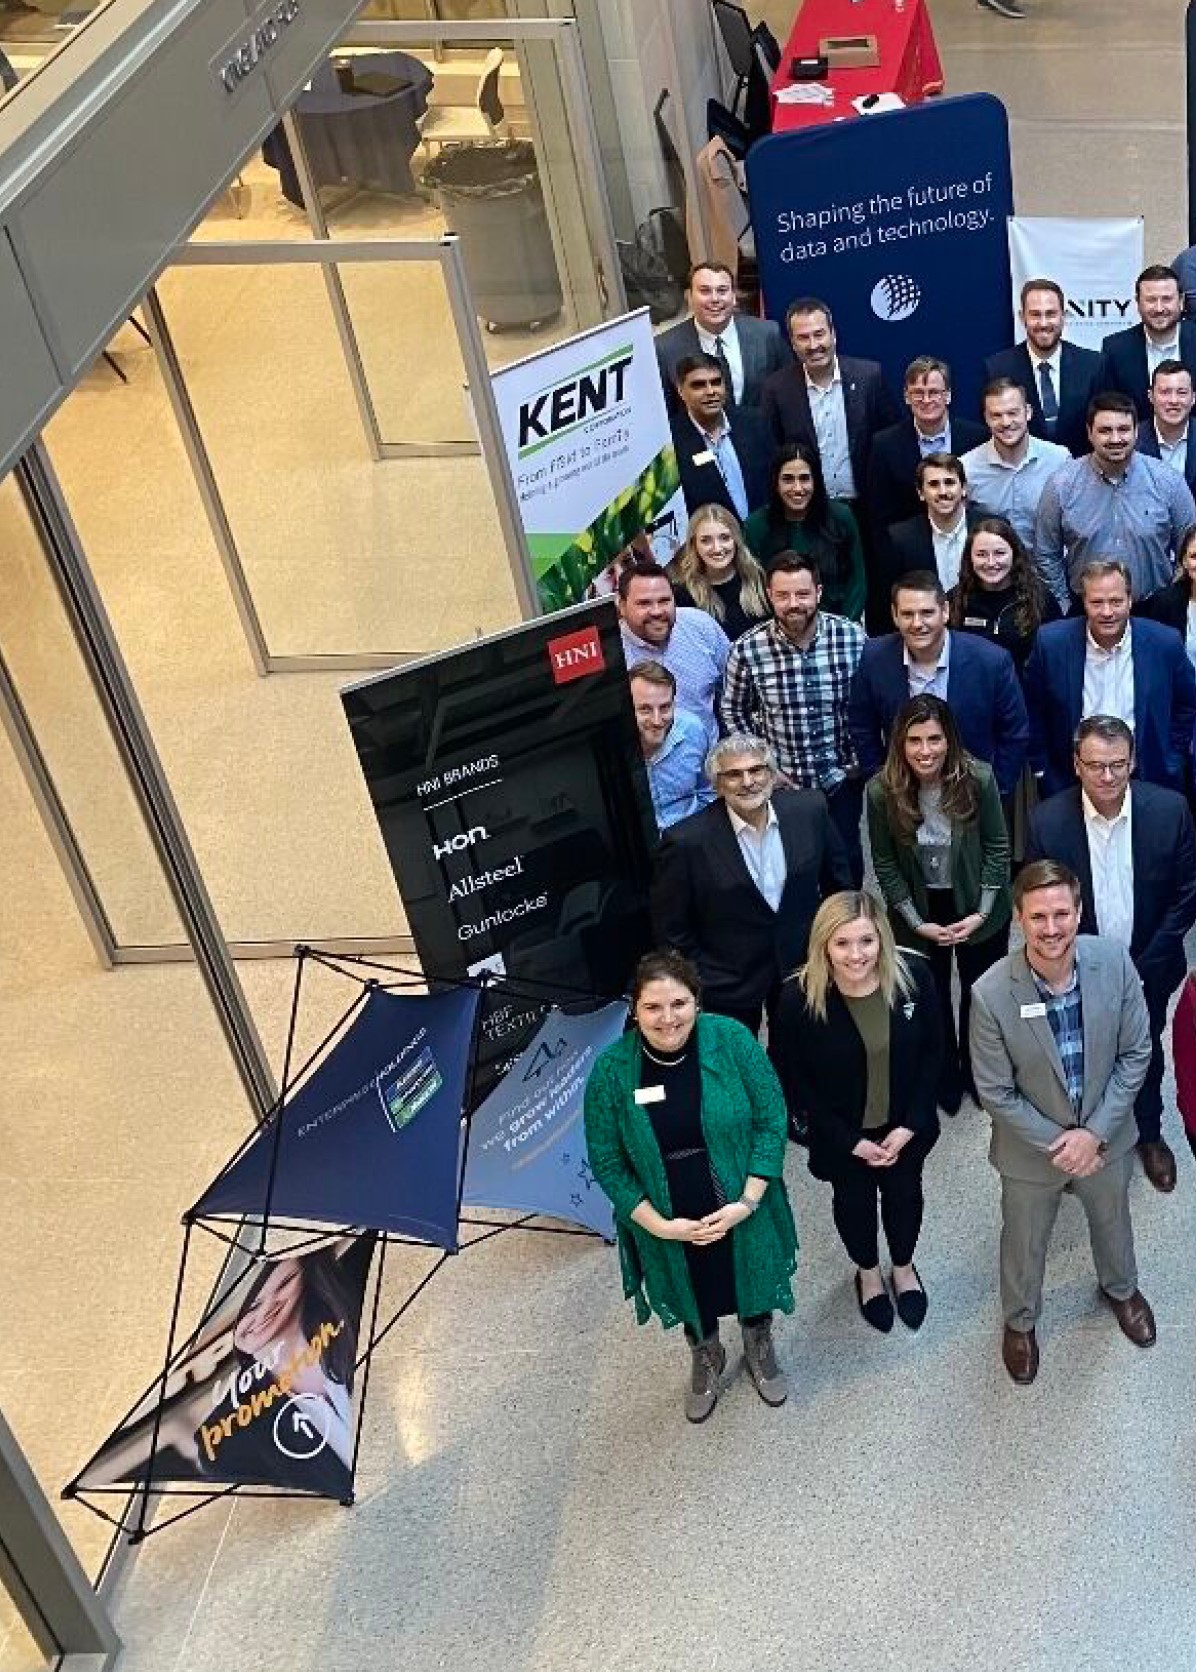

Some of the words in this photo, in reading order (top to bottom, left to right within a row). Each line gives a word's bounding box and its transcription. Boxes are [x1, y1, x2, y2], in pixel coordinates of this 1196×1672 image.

[777, 203, 866, 233] Shaping
[870, 195, 902, 214] the
[907, 182, 968, 208] future
[973, 171, 993, 194] of
[780, 241, 827, 263] data
[833, 227, 872, 252] and
[877, 208, 995, 242] technology.
[520, 355, 633, 448] KENT
[555, 641, 597, 669] HNI
[416, 777, 441, 796] HNI
[444, 754, 500, 786] BRANDS
[448, 855, 524, 903] Allsteel
[458, 895, 548, 940] Gunlocke
[504, 1119, 543, 1151] from
[509, 1098, 548, 1133] grow
